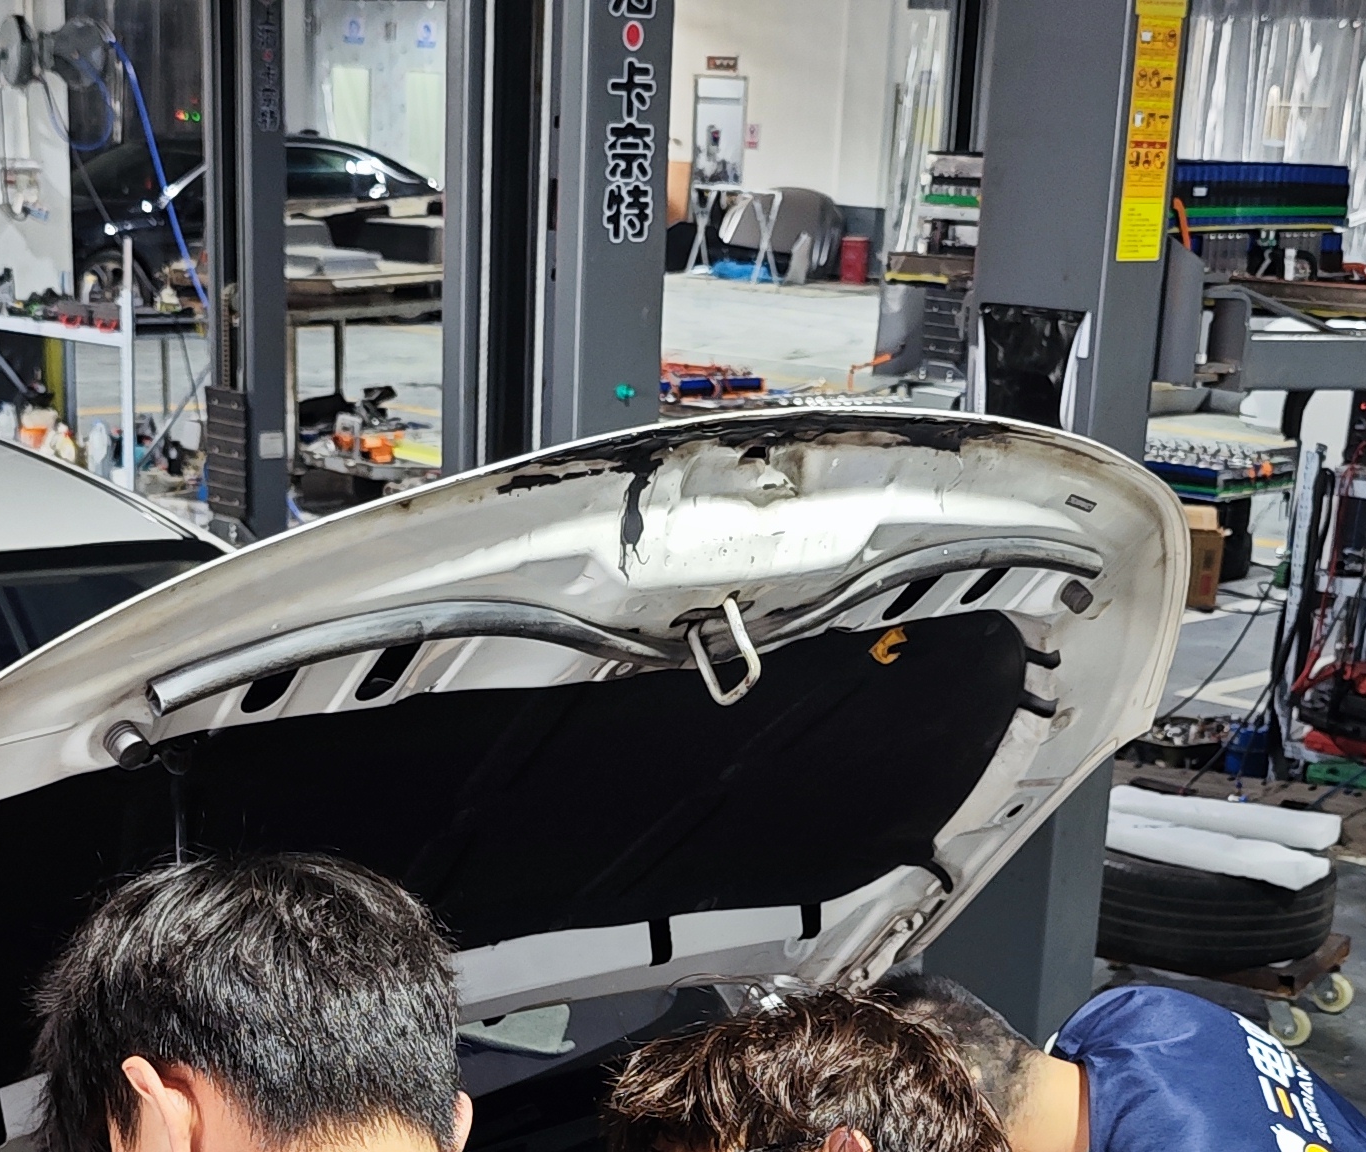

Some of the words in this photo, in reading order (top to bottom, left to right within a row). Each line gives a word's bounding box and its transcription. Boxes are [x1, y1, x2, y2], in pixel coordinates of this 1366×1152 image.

[603, 57, 657, 244] 卡奈特
[1285, 1049, 1333, 1145] SANDIAN
